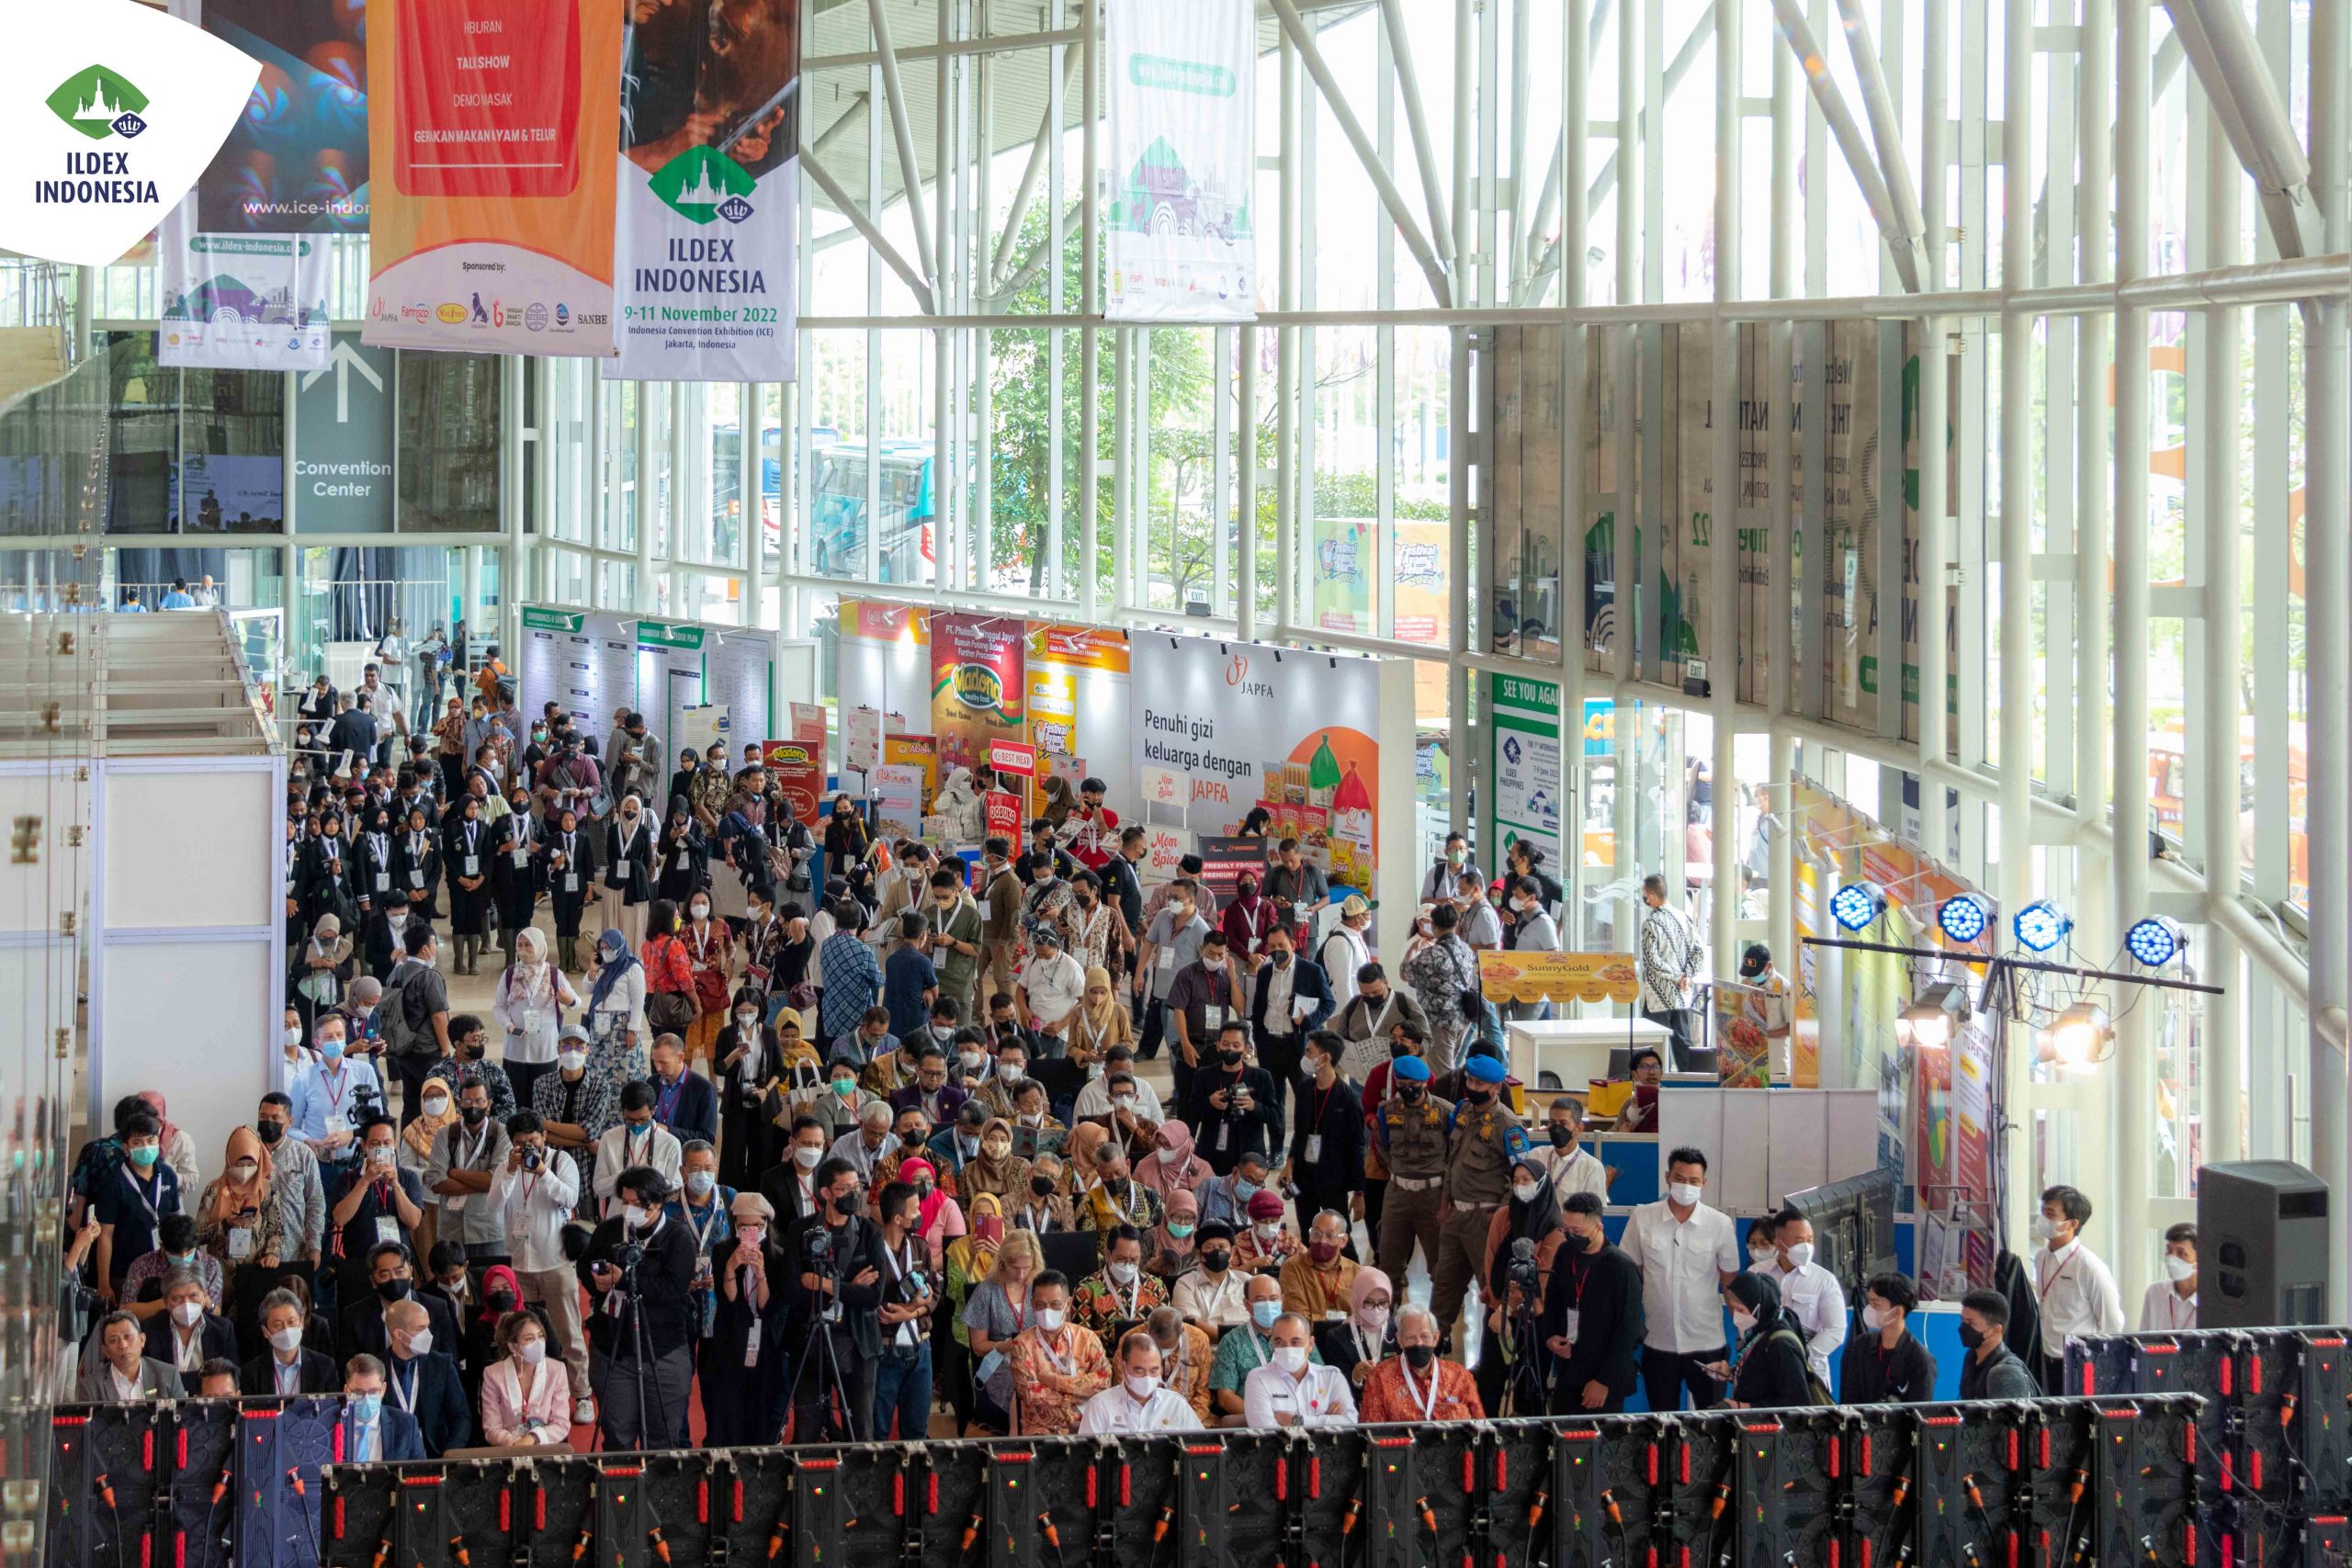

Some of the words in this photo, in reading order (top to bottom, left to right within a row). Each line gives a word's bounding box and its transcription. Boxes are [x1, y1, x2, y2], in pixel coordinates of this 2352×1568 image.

[453, 94, 480, 107] DEMO
[456, 130, 492, 142] MAKAN
[521, 130, 528, 142] &
[530, 128, 556, 141] TELUR
[198, 240, 304, 254] www.ildex-indonesia.cm
[669, 238, 734, 262] ILDEX
[462, 261, 495, 271] Sponsored
[636, 268, 766, 293] INDONESIA
[380, 312, 398, 322] JAPFA
[401, 304, 429, 320] Farmsco
[578, 314, 607, 325] SANBE
[625, 306, 655, 321] 9-11
[662, 305, 738, 321] November
[742, 308, 777, 322] 2022
[628, 326, 666, 335] Indonesia
[669, 326, 712, 335] Convention
[715, 327, 753, 336] Exhibition
[756, 328, 774, 338] (ICE)
[665, 340, 695, 350] Jakarta,
[698, 341, 736, 349] Indonesia
[295, 460, 391, 477] Convention
[313, 481, 371, 497] Center
[1191, 592, 1204, 602] EXIT
[945, 625, 955, 634] PT.
[1001, 631, 1015, 644] Jaya
[971, 639, 989, 651] Potong
[989, 642, 1004, 652] Bebek
[958, 648, 975, 658] Further
[976, 650, 1001, 664] Processing
[954, 663, 1001, 702] Madona
[1241, 682, 1273, 698] JAPFA
[965, 693, 979, 703] healthy
[980, 694, 990, 704] food
[1503, 679, 1518, 697] SEE
[1519, 682, 1536, 702] YOU
[1538, 686, 1558, 705] AGAI
[1145, 708, 1187, 735] Penuhi
[1191, 717, 1213, 741] gizi
[1001, 750, 1016, 762] BEST
[1145, 738, 1199, 771] keluarga
[1203, 750, 1251, 780] dengan
[1191, 778, 1229, 804] JAPFA
[1150, 830, 1179, 848] Mom
[1152, 851, 1181, 868] Spice
